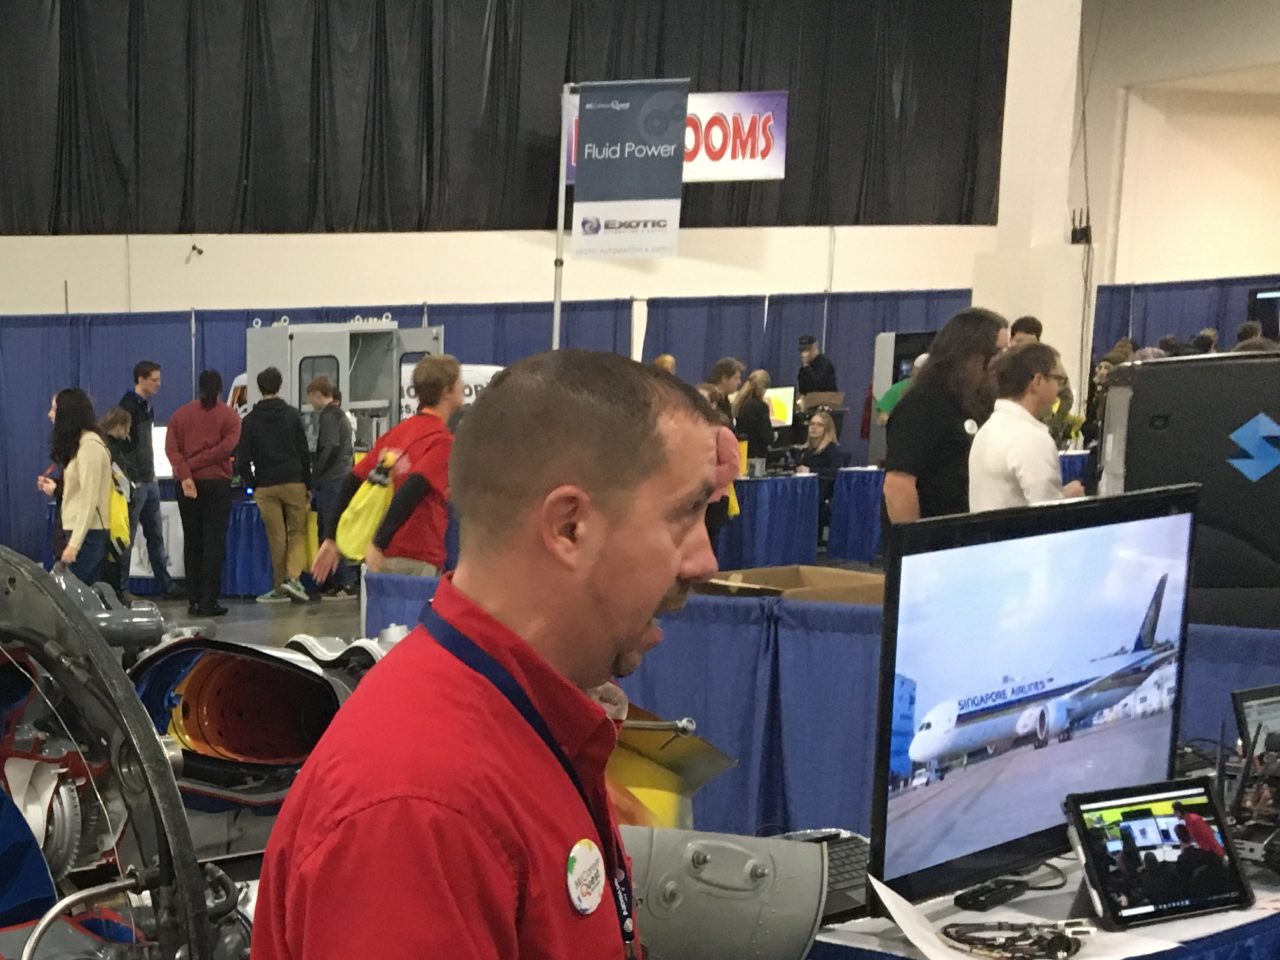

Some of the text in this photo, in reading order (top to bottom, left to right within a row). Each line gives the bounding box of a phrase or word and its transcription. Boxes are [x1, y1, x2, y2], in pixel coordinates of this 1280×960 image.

[585, 142, 677, 159] Fluid Power
[604, 219, 667, 229] EXOTIC
[958, 689, 1008, 711] SINGAPORE
